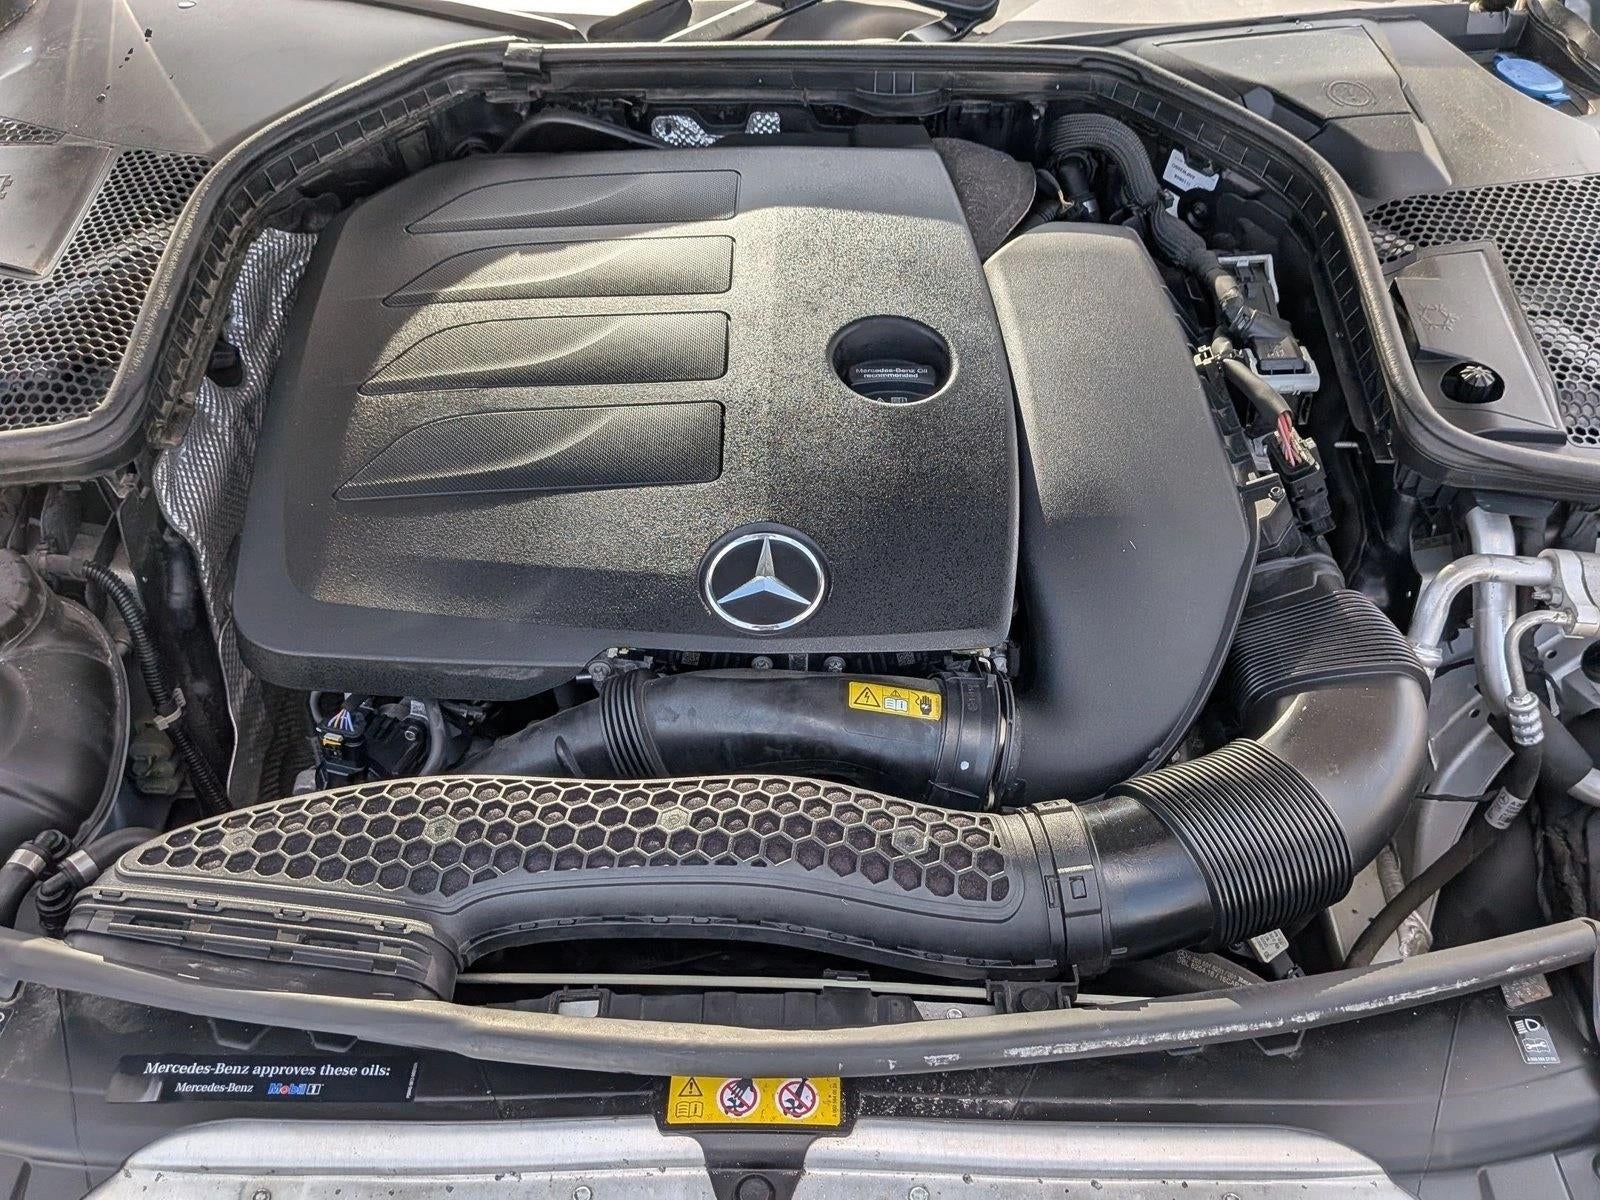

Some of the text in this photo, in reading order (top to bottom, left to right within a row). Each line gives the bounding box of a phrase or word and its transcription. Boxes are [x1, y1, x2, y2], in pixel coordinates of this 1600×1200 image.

[855, 367, 915, 375] Mercedes-Benz
[143, 1062, 392, 1078] Mercedes-Benz approves these oils:
[174, 1082, 255, 1093] Mercedes-Benz
[267, 1083, 307, 1095] Mobil
